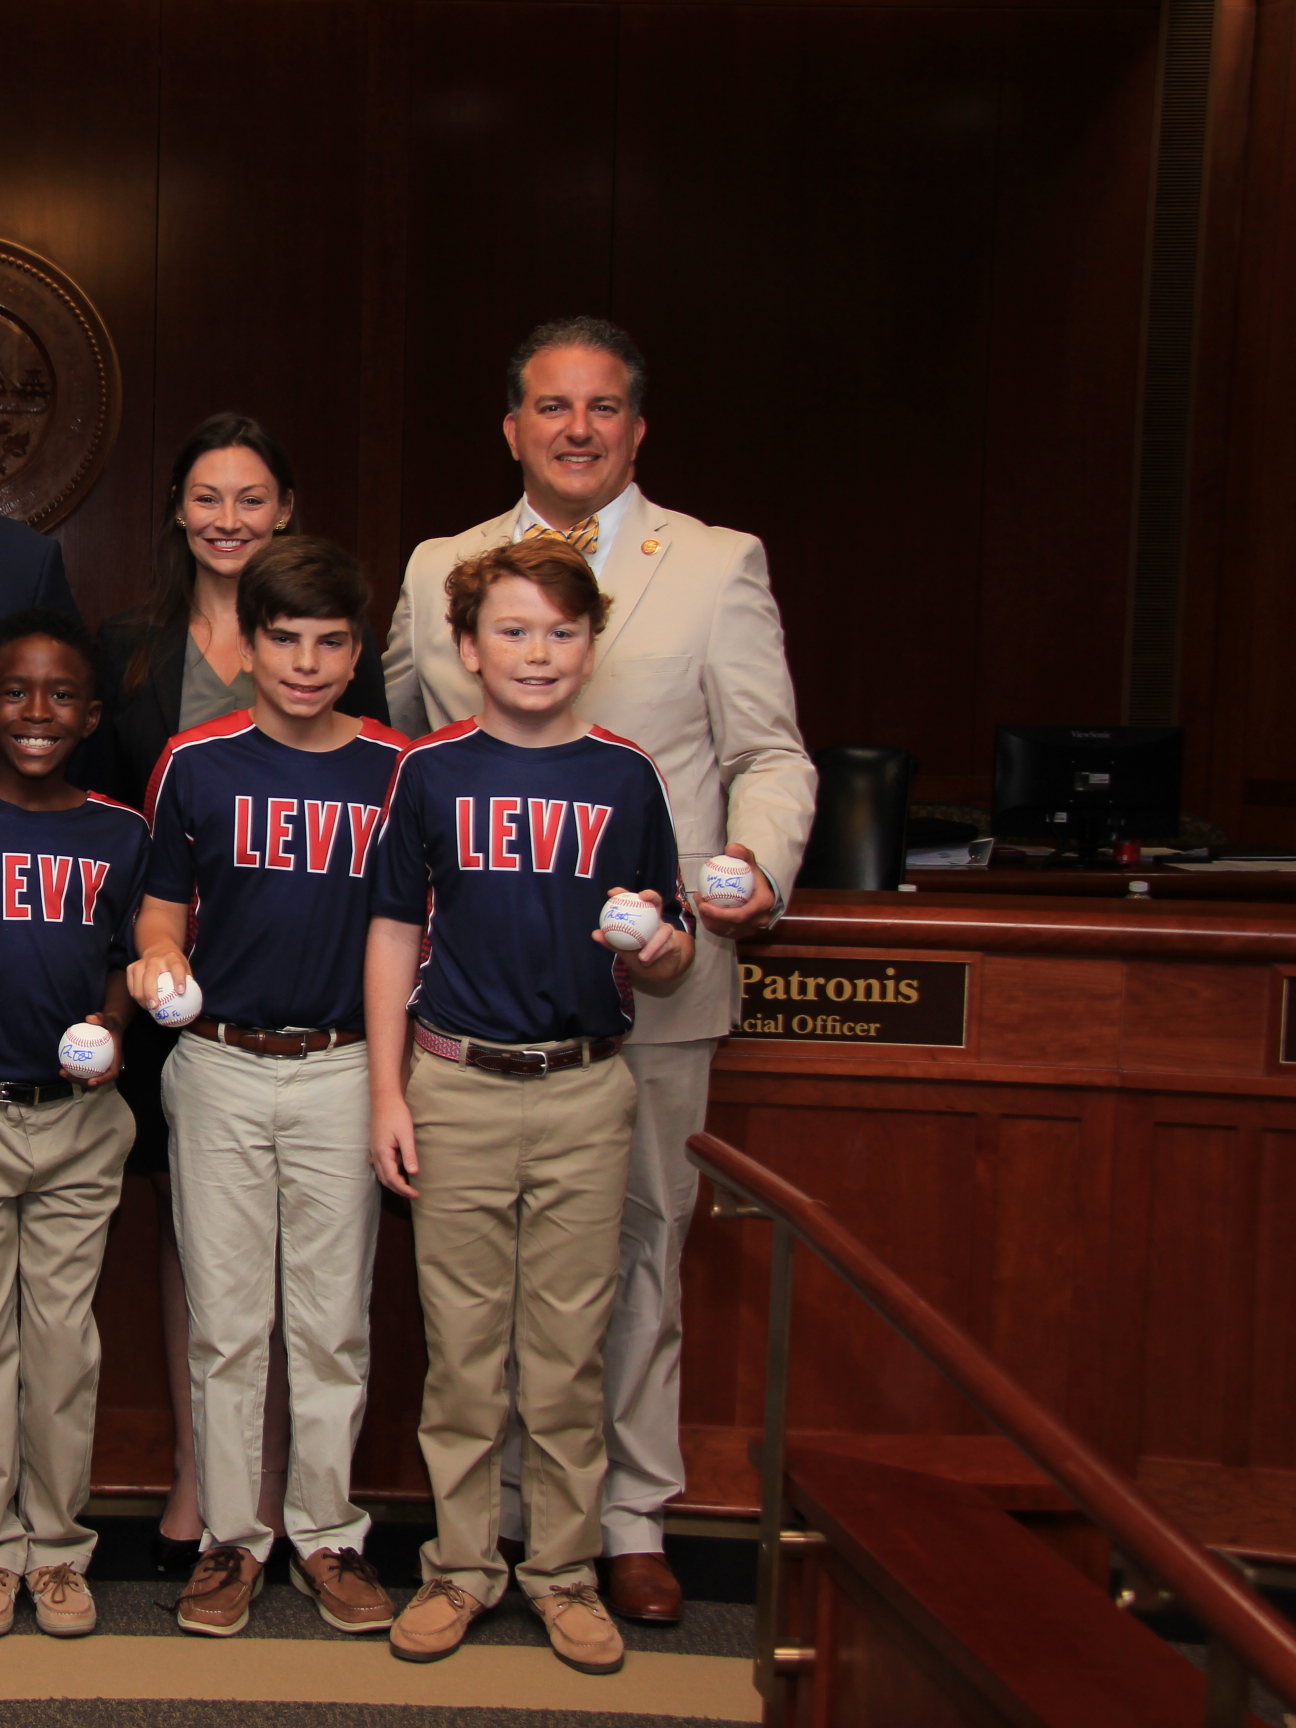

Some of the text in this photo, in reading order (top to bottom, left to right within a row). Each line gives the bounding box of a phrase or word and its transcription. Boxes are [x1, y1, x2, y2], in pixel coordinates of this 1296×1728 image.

[234, 795, 381, 878] LEVY
[456, 797, 613, 879] LEVY
[738, 963, 919, 1004] Patronis
[730, 1013, 881, 1036] cial Officer
